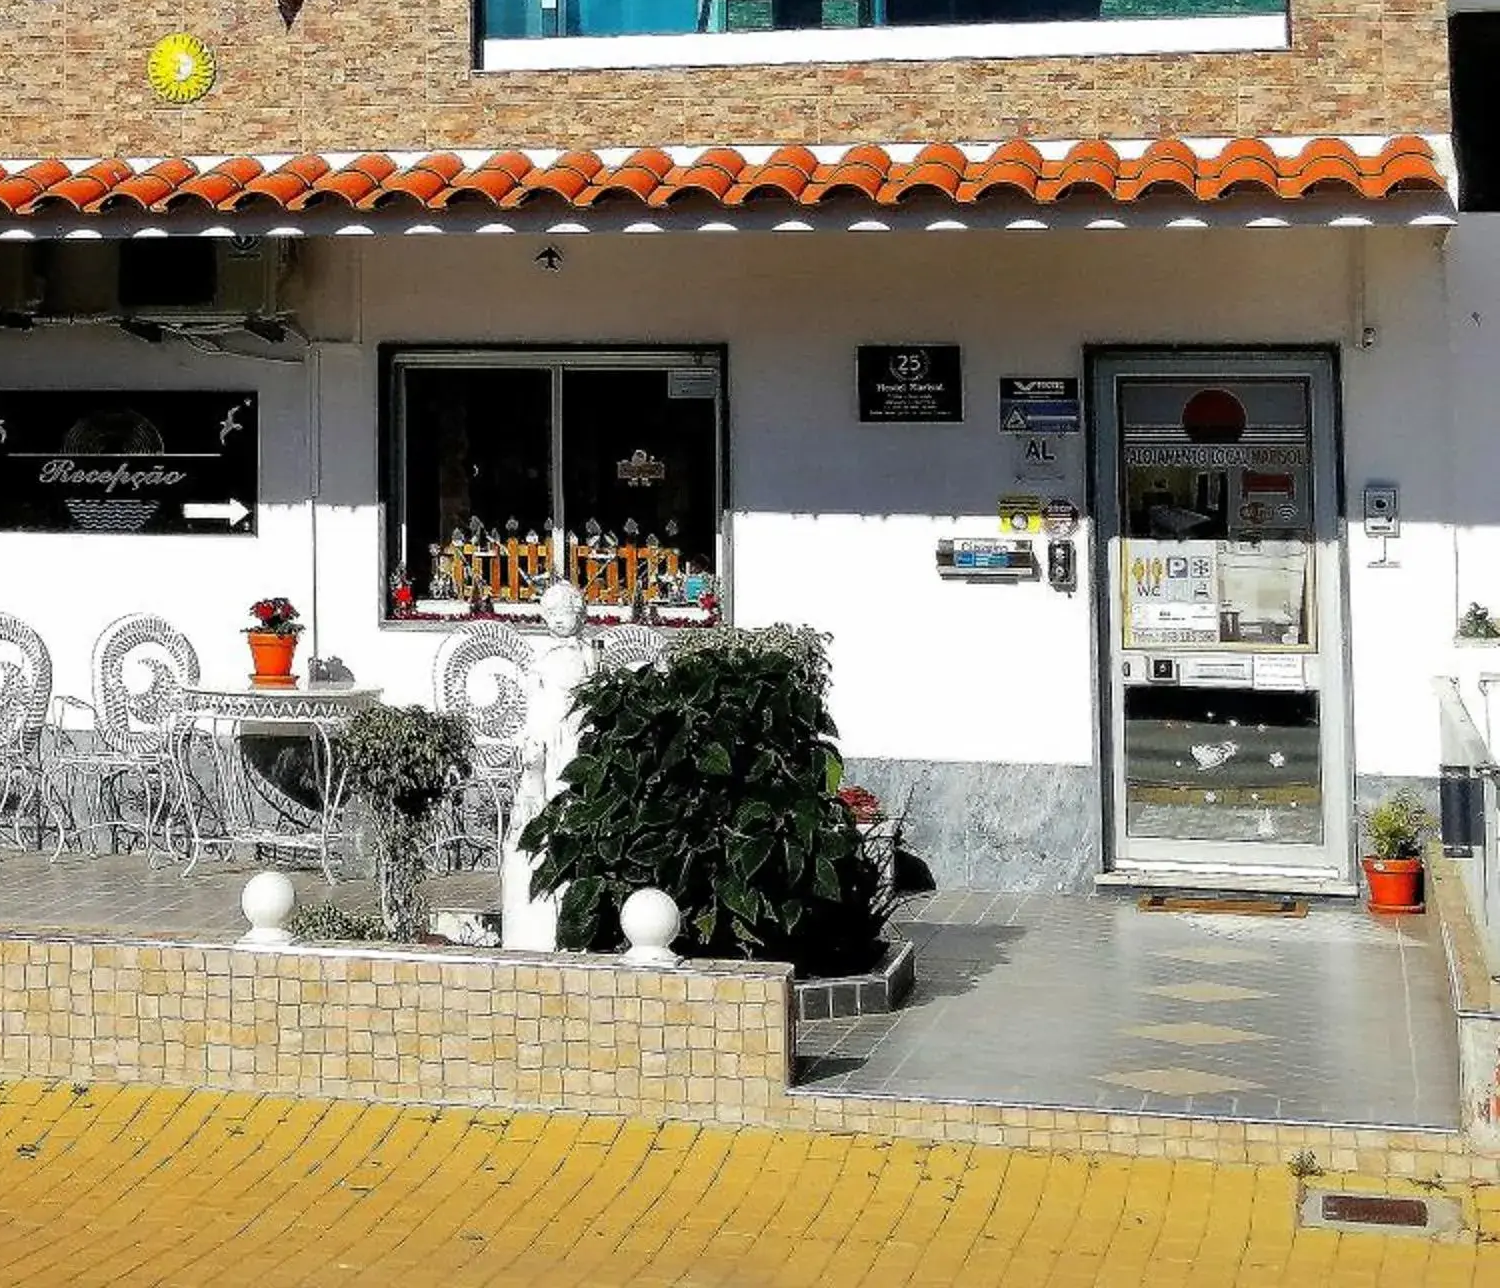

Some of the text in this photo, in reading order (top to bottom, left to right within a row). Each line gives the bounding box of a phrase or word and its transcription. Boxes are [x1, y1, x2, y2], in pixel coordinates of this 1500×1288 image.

[896, 354, 921, 371] 25
[1025, 439, 1055, 461] AL
[38, 458, 188, 493] Recepção
[1136, 585, 1162, 598] WC
